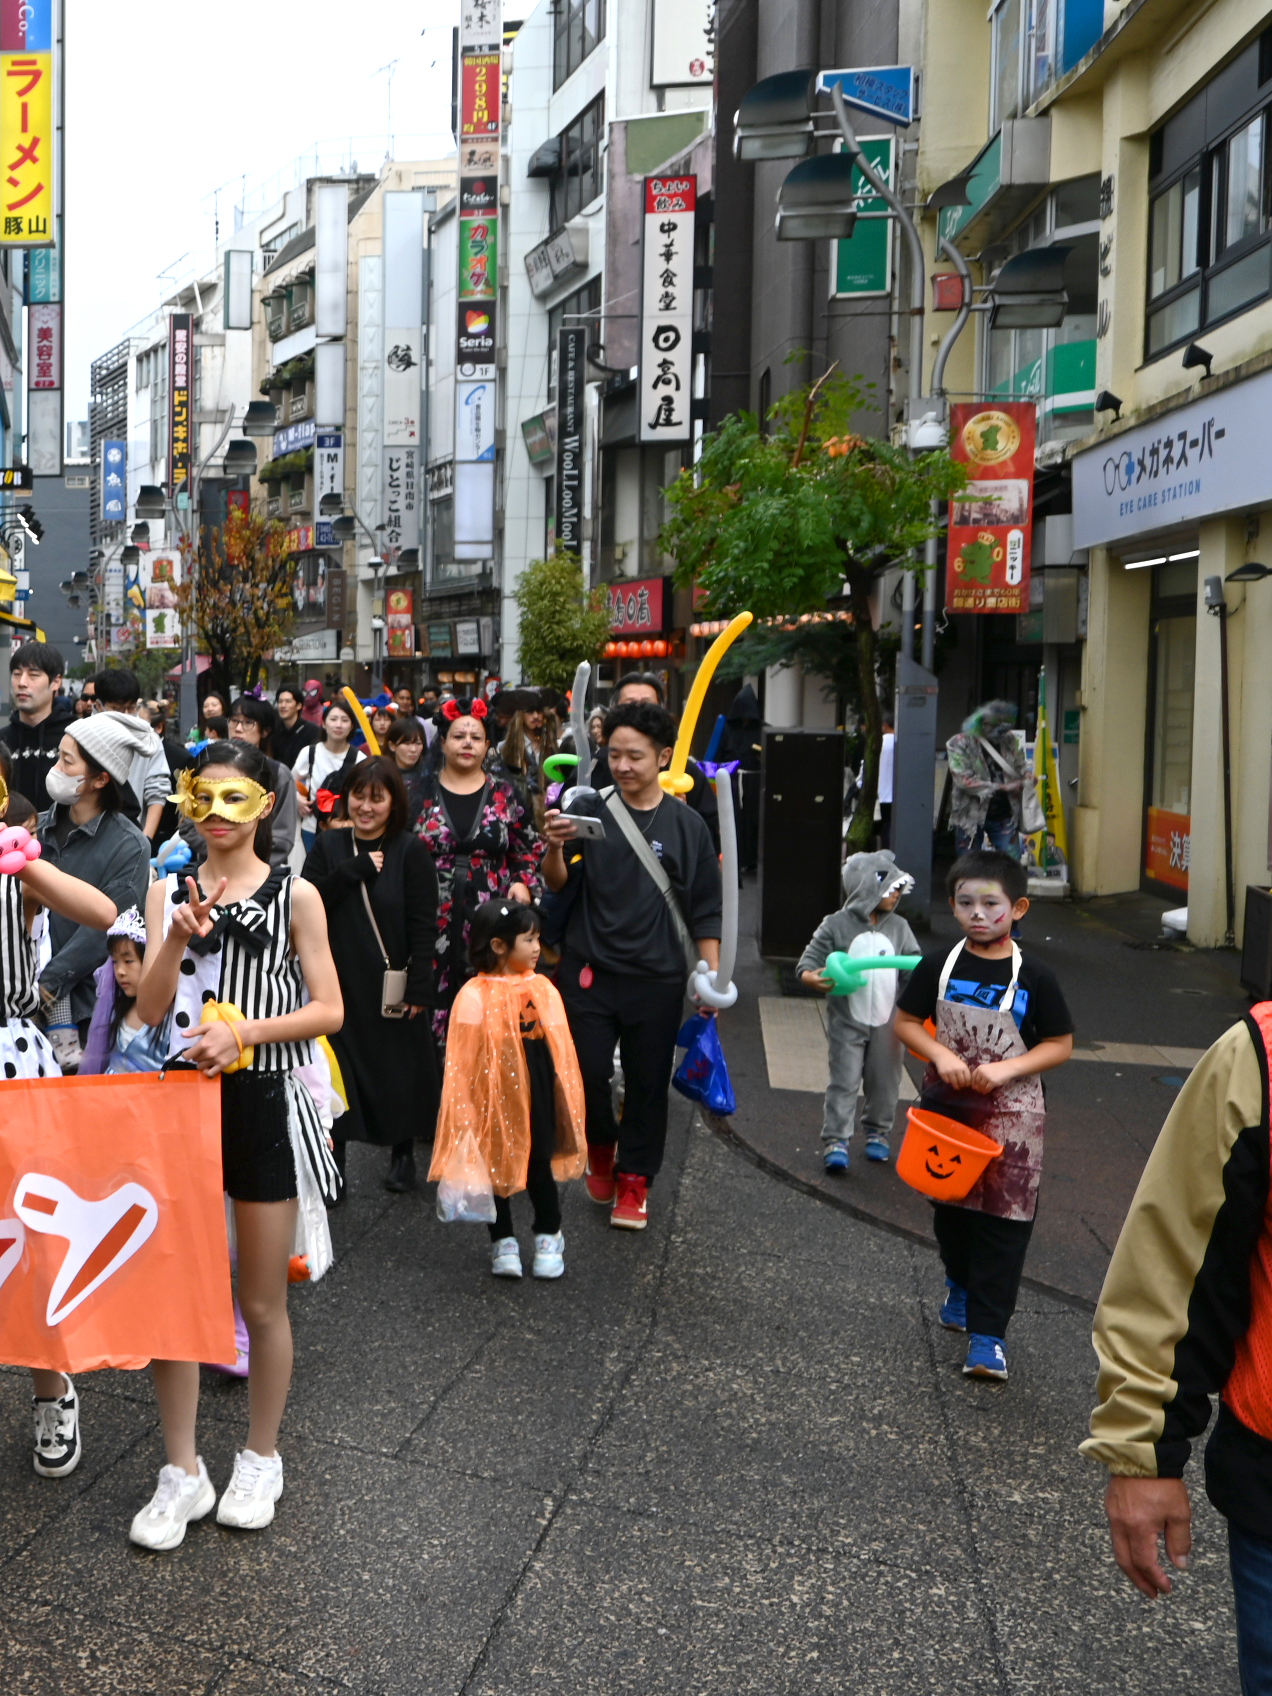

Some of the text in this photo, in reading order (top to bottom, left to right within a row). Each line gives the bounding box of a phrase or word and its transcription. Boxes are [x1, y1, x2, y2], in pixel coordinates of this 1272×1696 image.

[6, 59, 44, 211] ラーメン
[651, 180, 689, 194] ちょい
[655, 196, 686, 211] 飲み
[4, 215, 47, 235] 豚山
[469, 224, 488, 288] カラオケ
[659, 219, 679, 311] 中華食堂
[36, 326, 53, 378] 美容室
[459, 335, 493, 348] Seria
[479, 367, 490, 376] 1F
[648, 325, 683, 430] 日高屋
[567, 370, 576, 433] RESTAURANT
[1136, 417, 1226, 485] メガネスーパー
[387, 457, 401, 543] じとっこ組合
[1119, 478, 1201, 517] EYE CARE STATION
[332, 578, 342, 622] BEGIN
